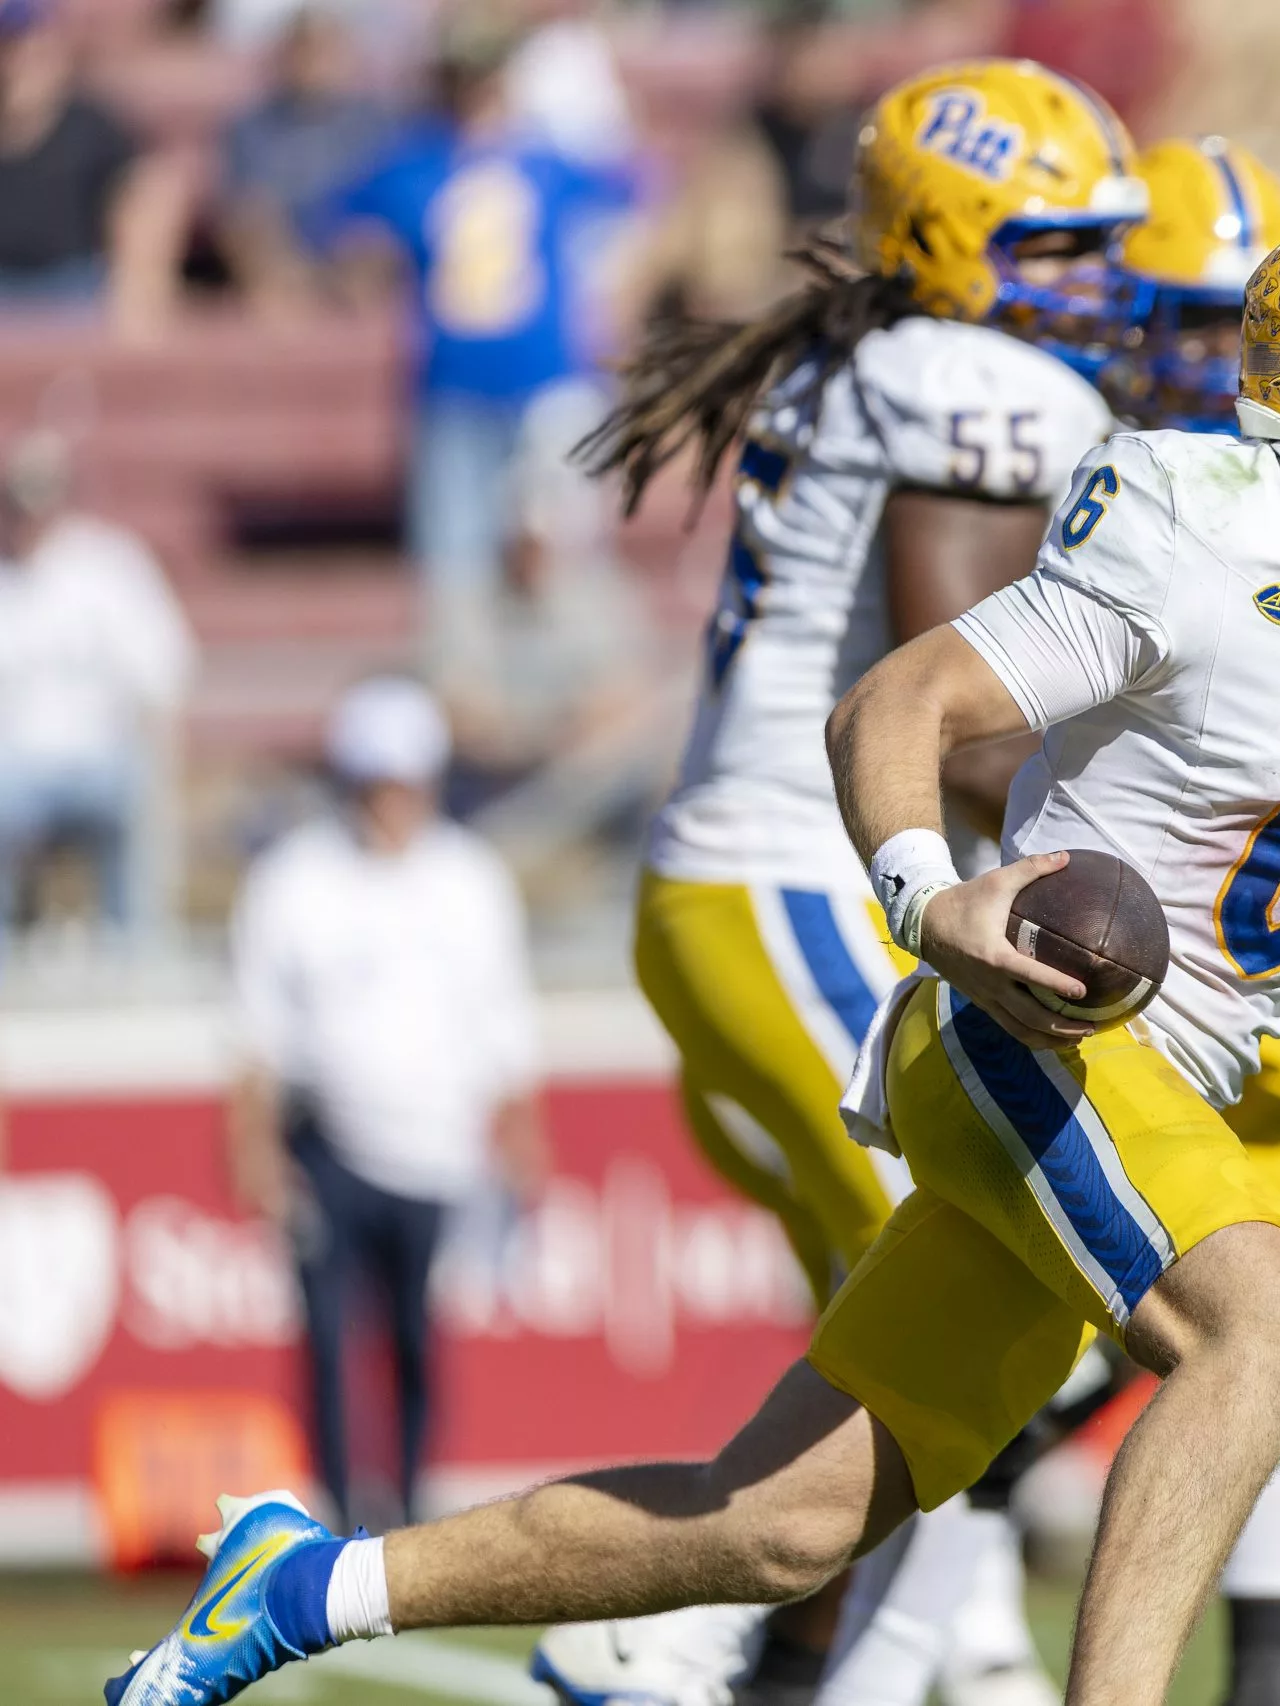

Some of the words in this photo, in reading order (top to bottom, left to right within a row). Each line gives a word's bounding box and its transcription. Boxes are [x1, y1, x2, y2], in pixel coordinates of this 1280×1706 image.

[917, 88, 1022, 181] Pitt
[948, 409, 1042, 492] 55
[1062, 463, 1120, 552] 6
